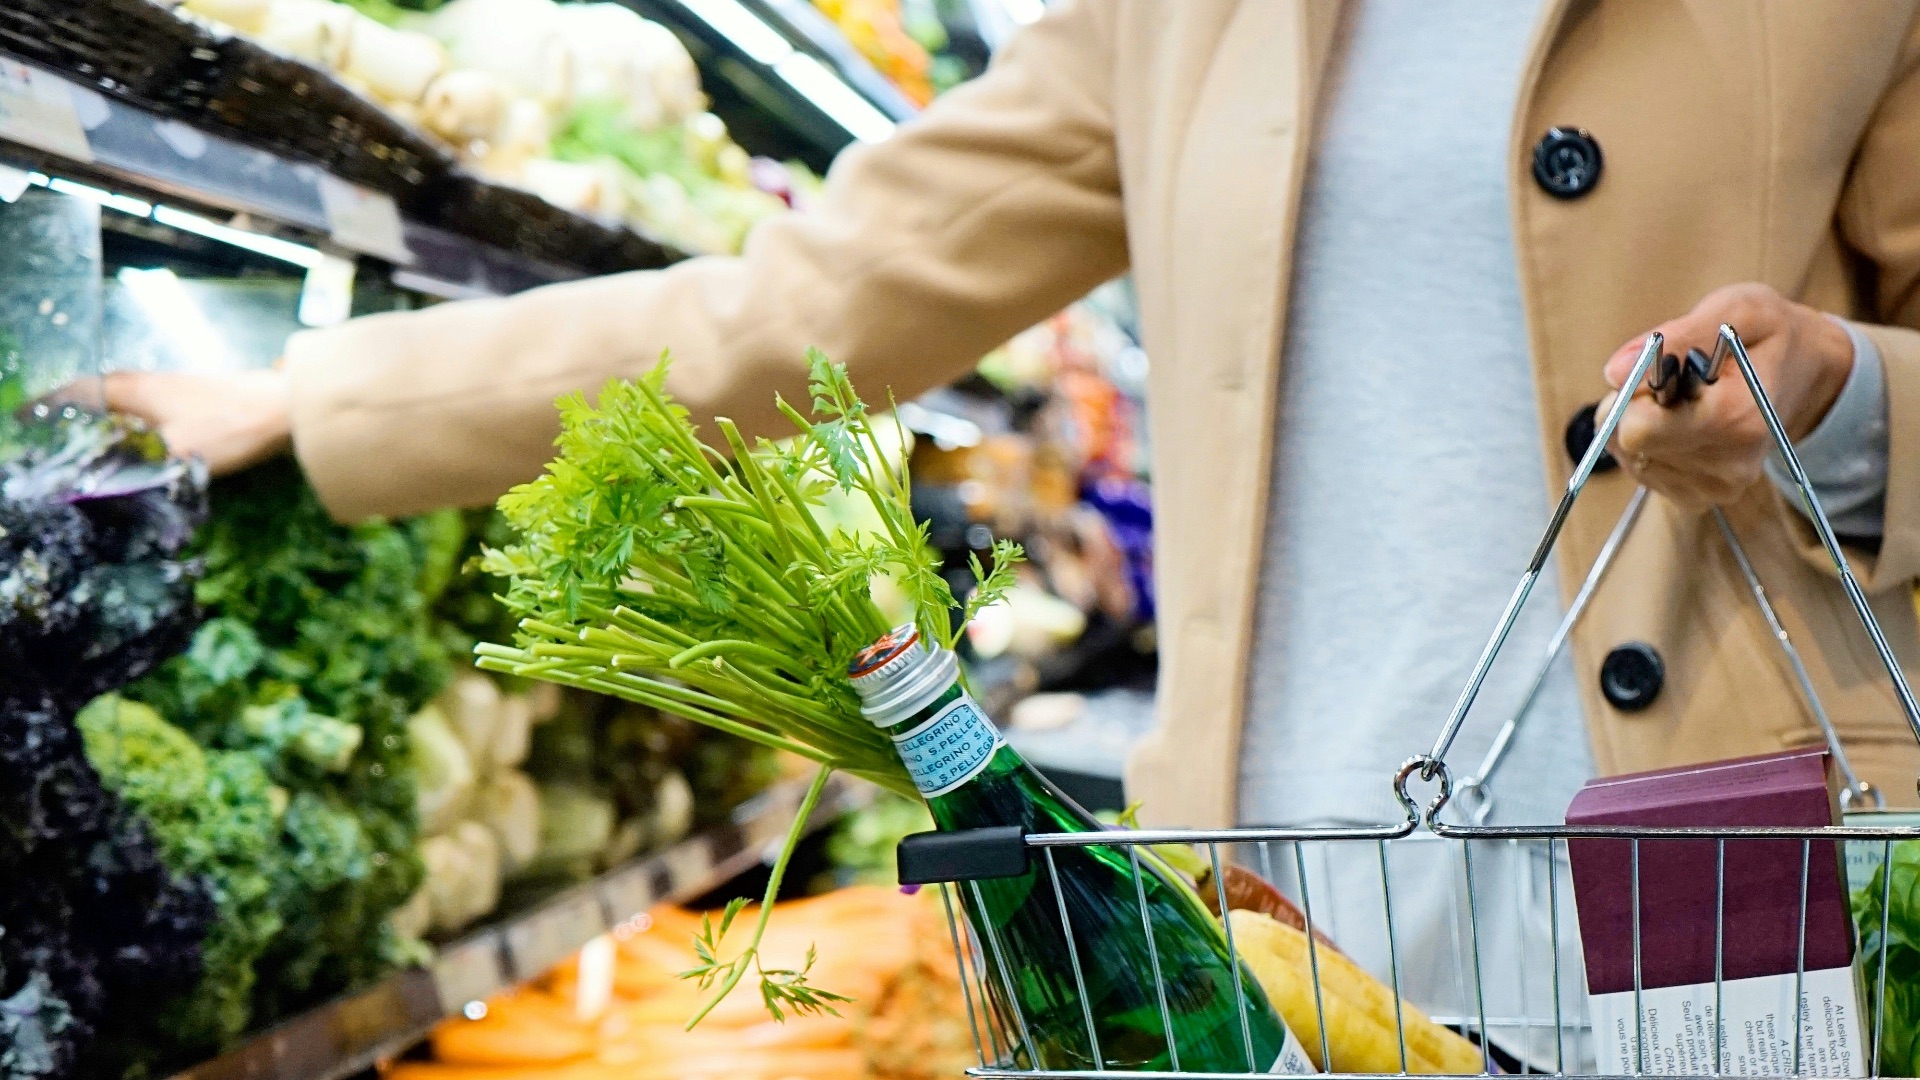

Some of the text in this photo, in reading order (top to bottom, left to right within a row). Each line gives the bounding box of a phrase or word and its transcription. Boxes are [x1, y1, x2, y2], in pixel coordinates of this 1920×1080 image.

[1705, 1005, 1713, 1017] de
[1823, 996, 1834, 1037] delicious
[1835, 1004, 1844, 1015] At
[1617, 1018, 1626, 1041] vous
[1648, 1008, 1660, 1051] Délicieux
[1654, 1053, 1662, 1066] au
[1682, 1000, 1699, 1071] Seul un produit
[1694, 1014, 1704, 1037] avec
[1755, 1020, 1765, 1035] but
[1836, 1017, 1847, 1048] Lesley
[1620, 1043, 1628, 1055] ne
[1745, 1020, 1755, 1055] cheese
[1750, 1057, 1757, 1066] or
[1758, 1038, 1769, 1063] really
[1765, 1013, 1780, 1074] these unique
[1806, 1035, 1814, 1050] her
[1828, 1039, 1839, 1063] food.
[1781, 1049, 1793, 1077] CRIS
[1818, 1047, 1827, 1063] are
